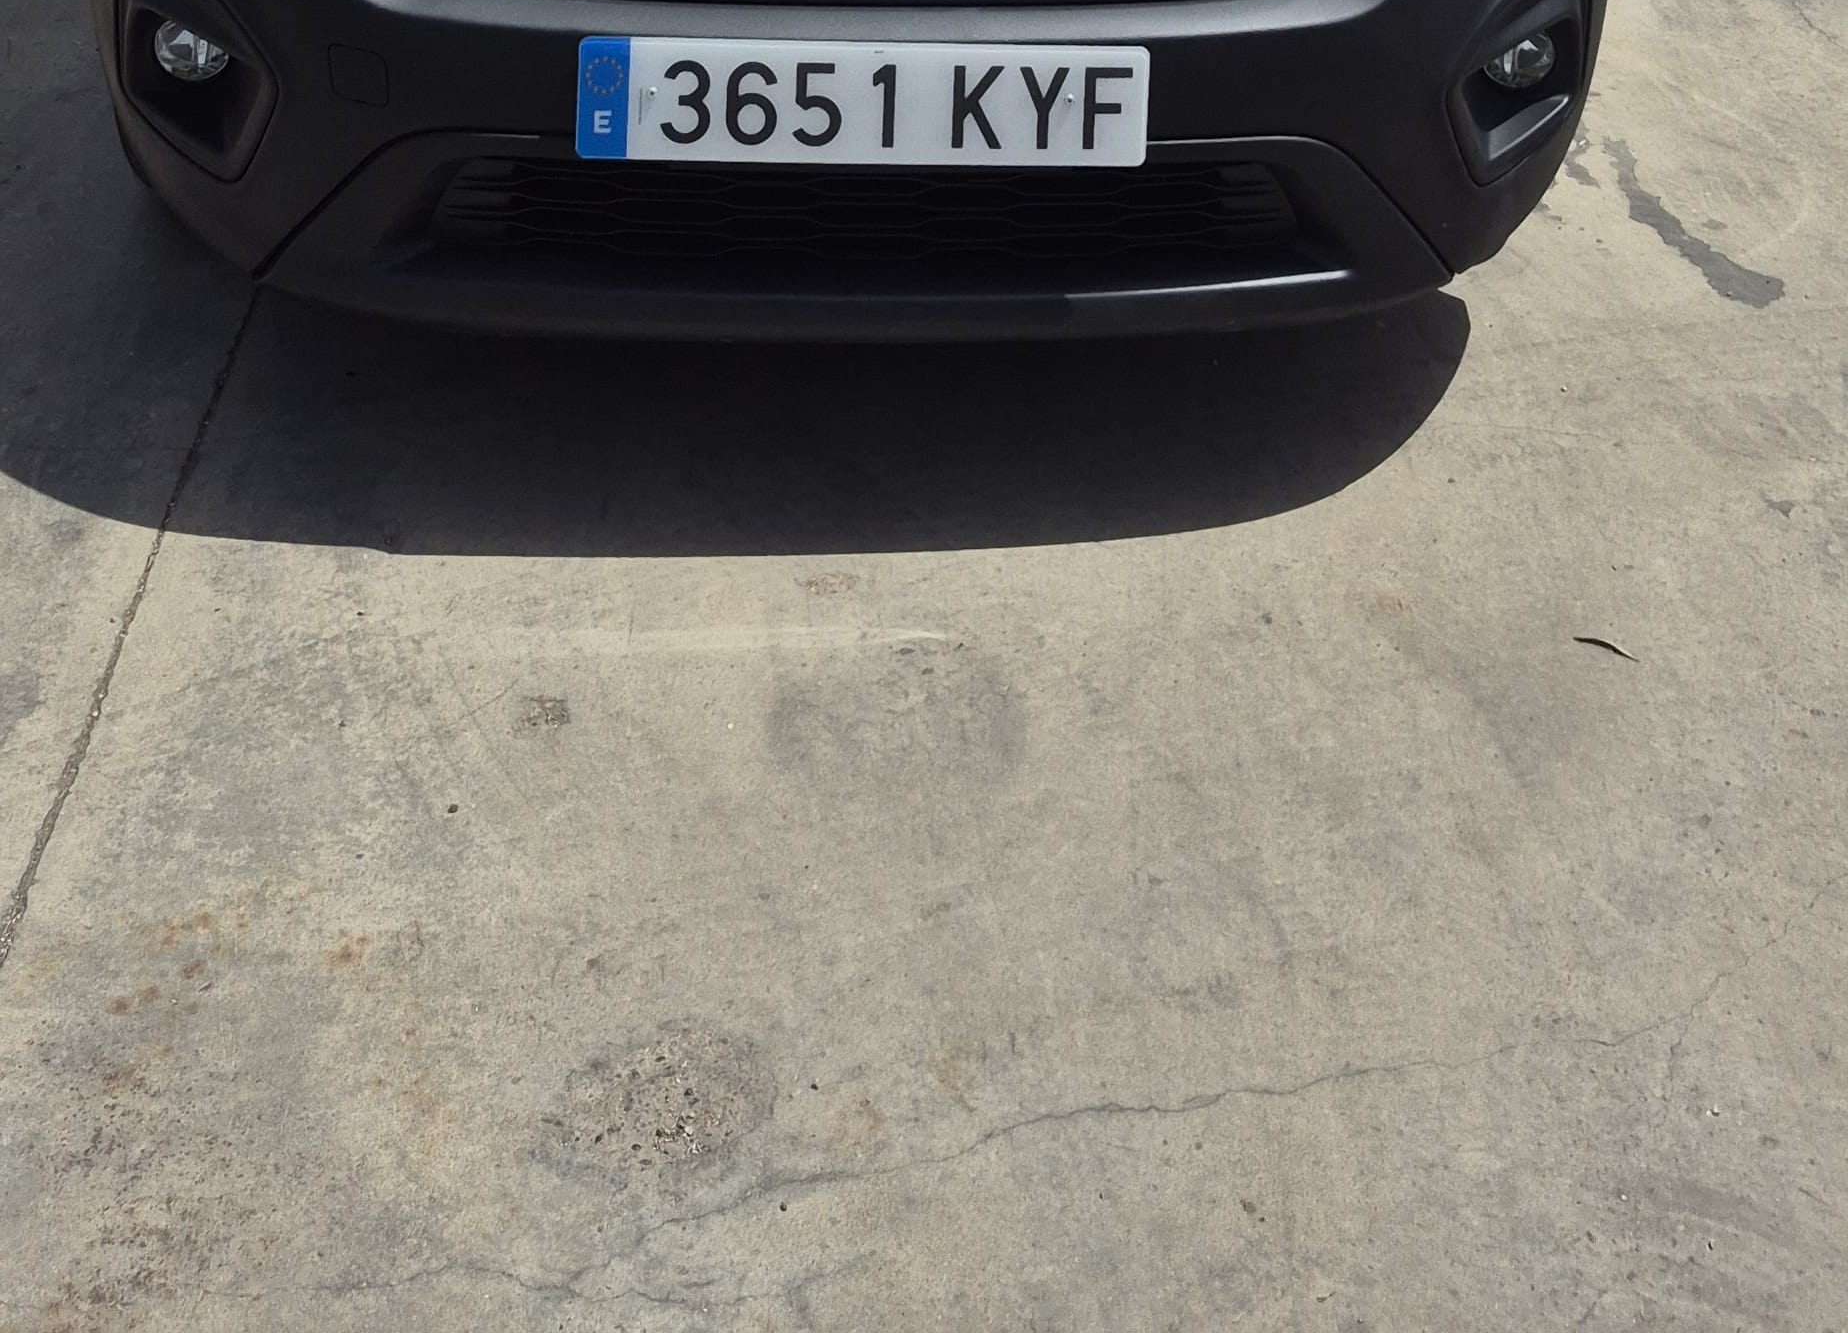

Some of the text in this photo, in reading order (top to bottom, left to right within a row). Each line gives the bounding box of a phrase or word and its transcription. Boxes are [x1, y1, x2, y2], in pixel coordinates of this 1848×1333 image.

[593, 110, 612, 134] E
[660, 60, 897, 149] 3651
[949, 65, 1134, 150] KYF
